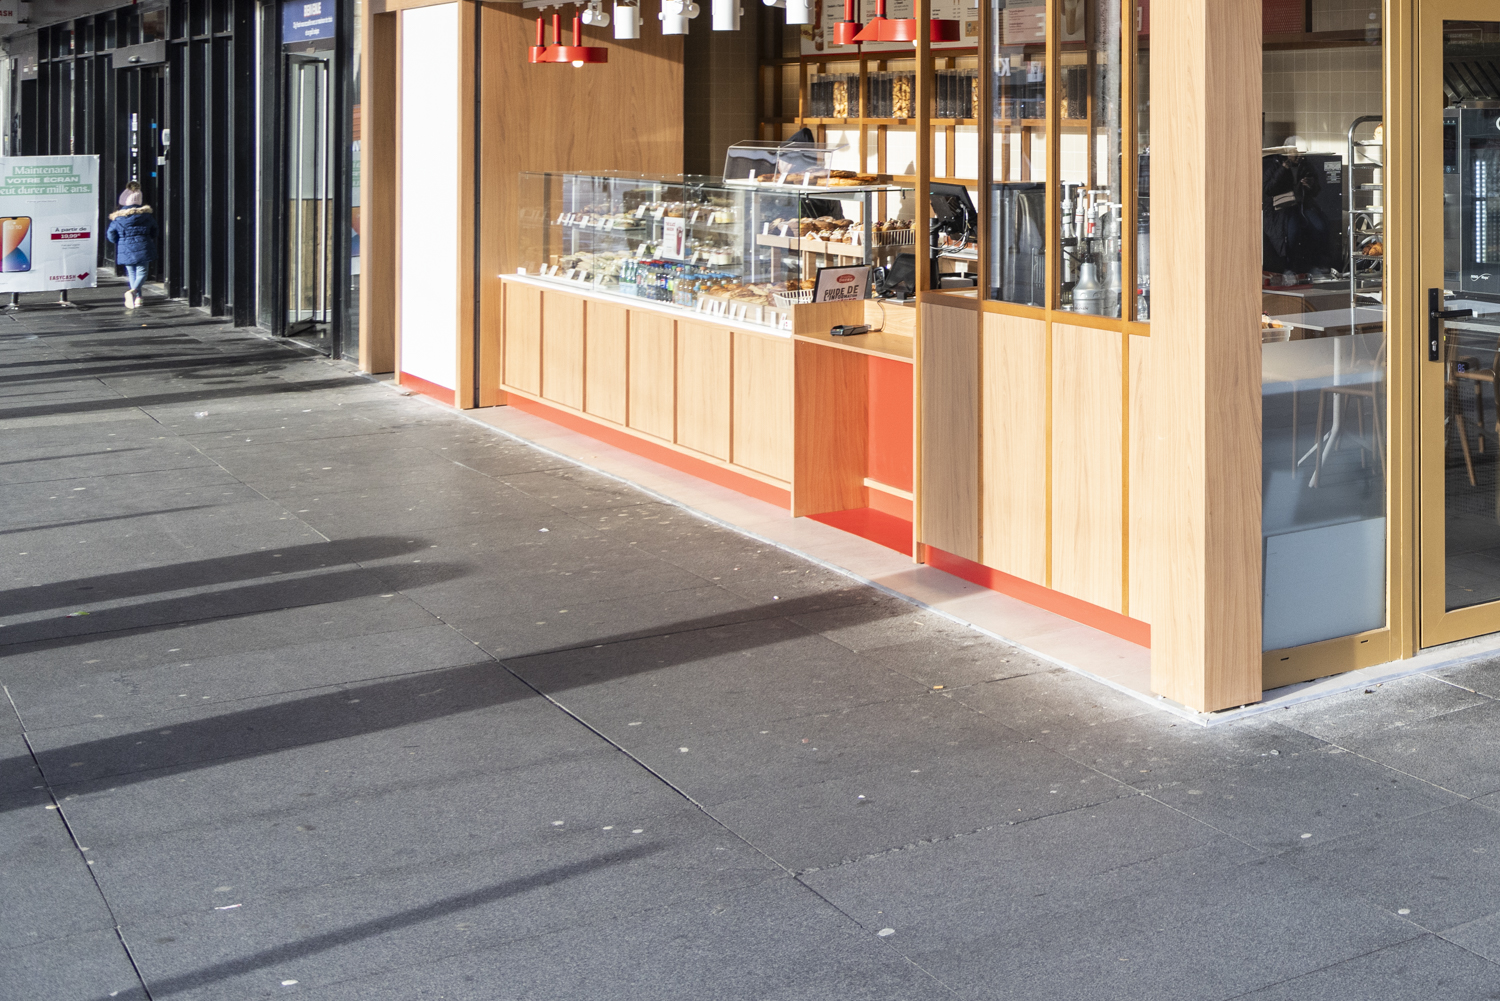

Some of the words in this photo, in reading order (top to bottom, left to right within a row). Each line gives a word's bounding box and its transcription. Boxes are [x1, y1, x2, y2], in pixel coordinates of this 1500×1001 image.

[14, 165, 71, 175] Maintenant
[18, 186, 45, 194] durer
[46, 185, 69, 193] mille
[825, 287, 845, 296] GUIDE
[847, 284, 859, 294] DE
